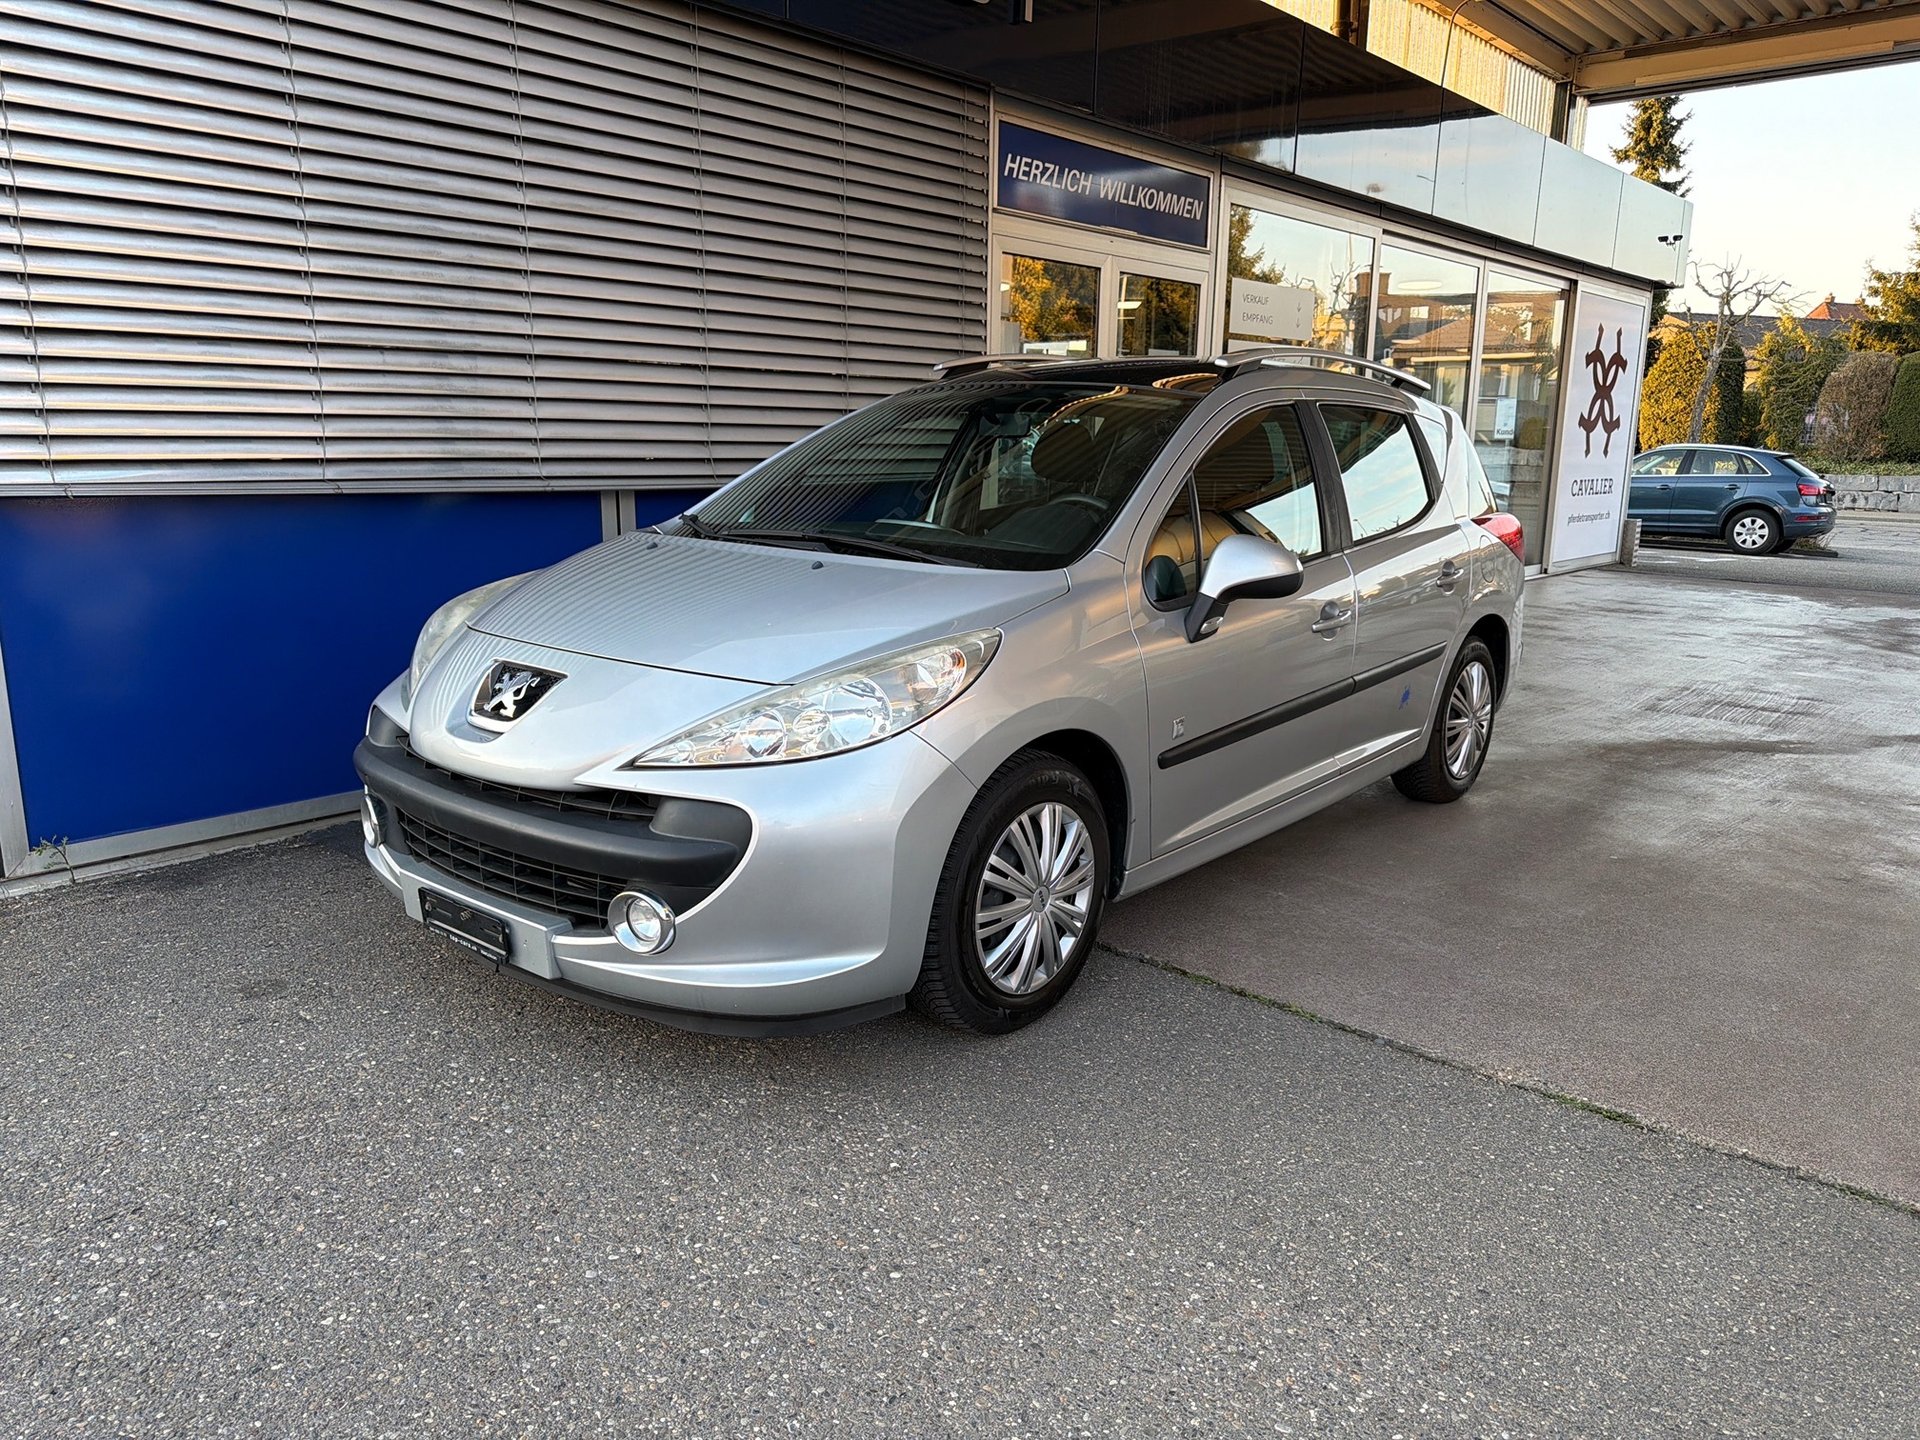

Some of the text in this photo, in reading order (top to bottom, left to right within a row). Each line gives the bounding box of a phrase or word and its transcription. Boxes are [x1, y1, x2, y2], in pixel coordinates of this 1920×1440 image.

[1003, 152, 1204, 221] HERZLICH WILLKOMMEN
[1242, 293, 1270, 306] VERKAUF
[1242, 311, 1274, 325] EMPFANG
[1571, 478, 1614, 497] CAVALIER
[1567, 510, 1610, 526] pferdetransporter.ch
